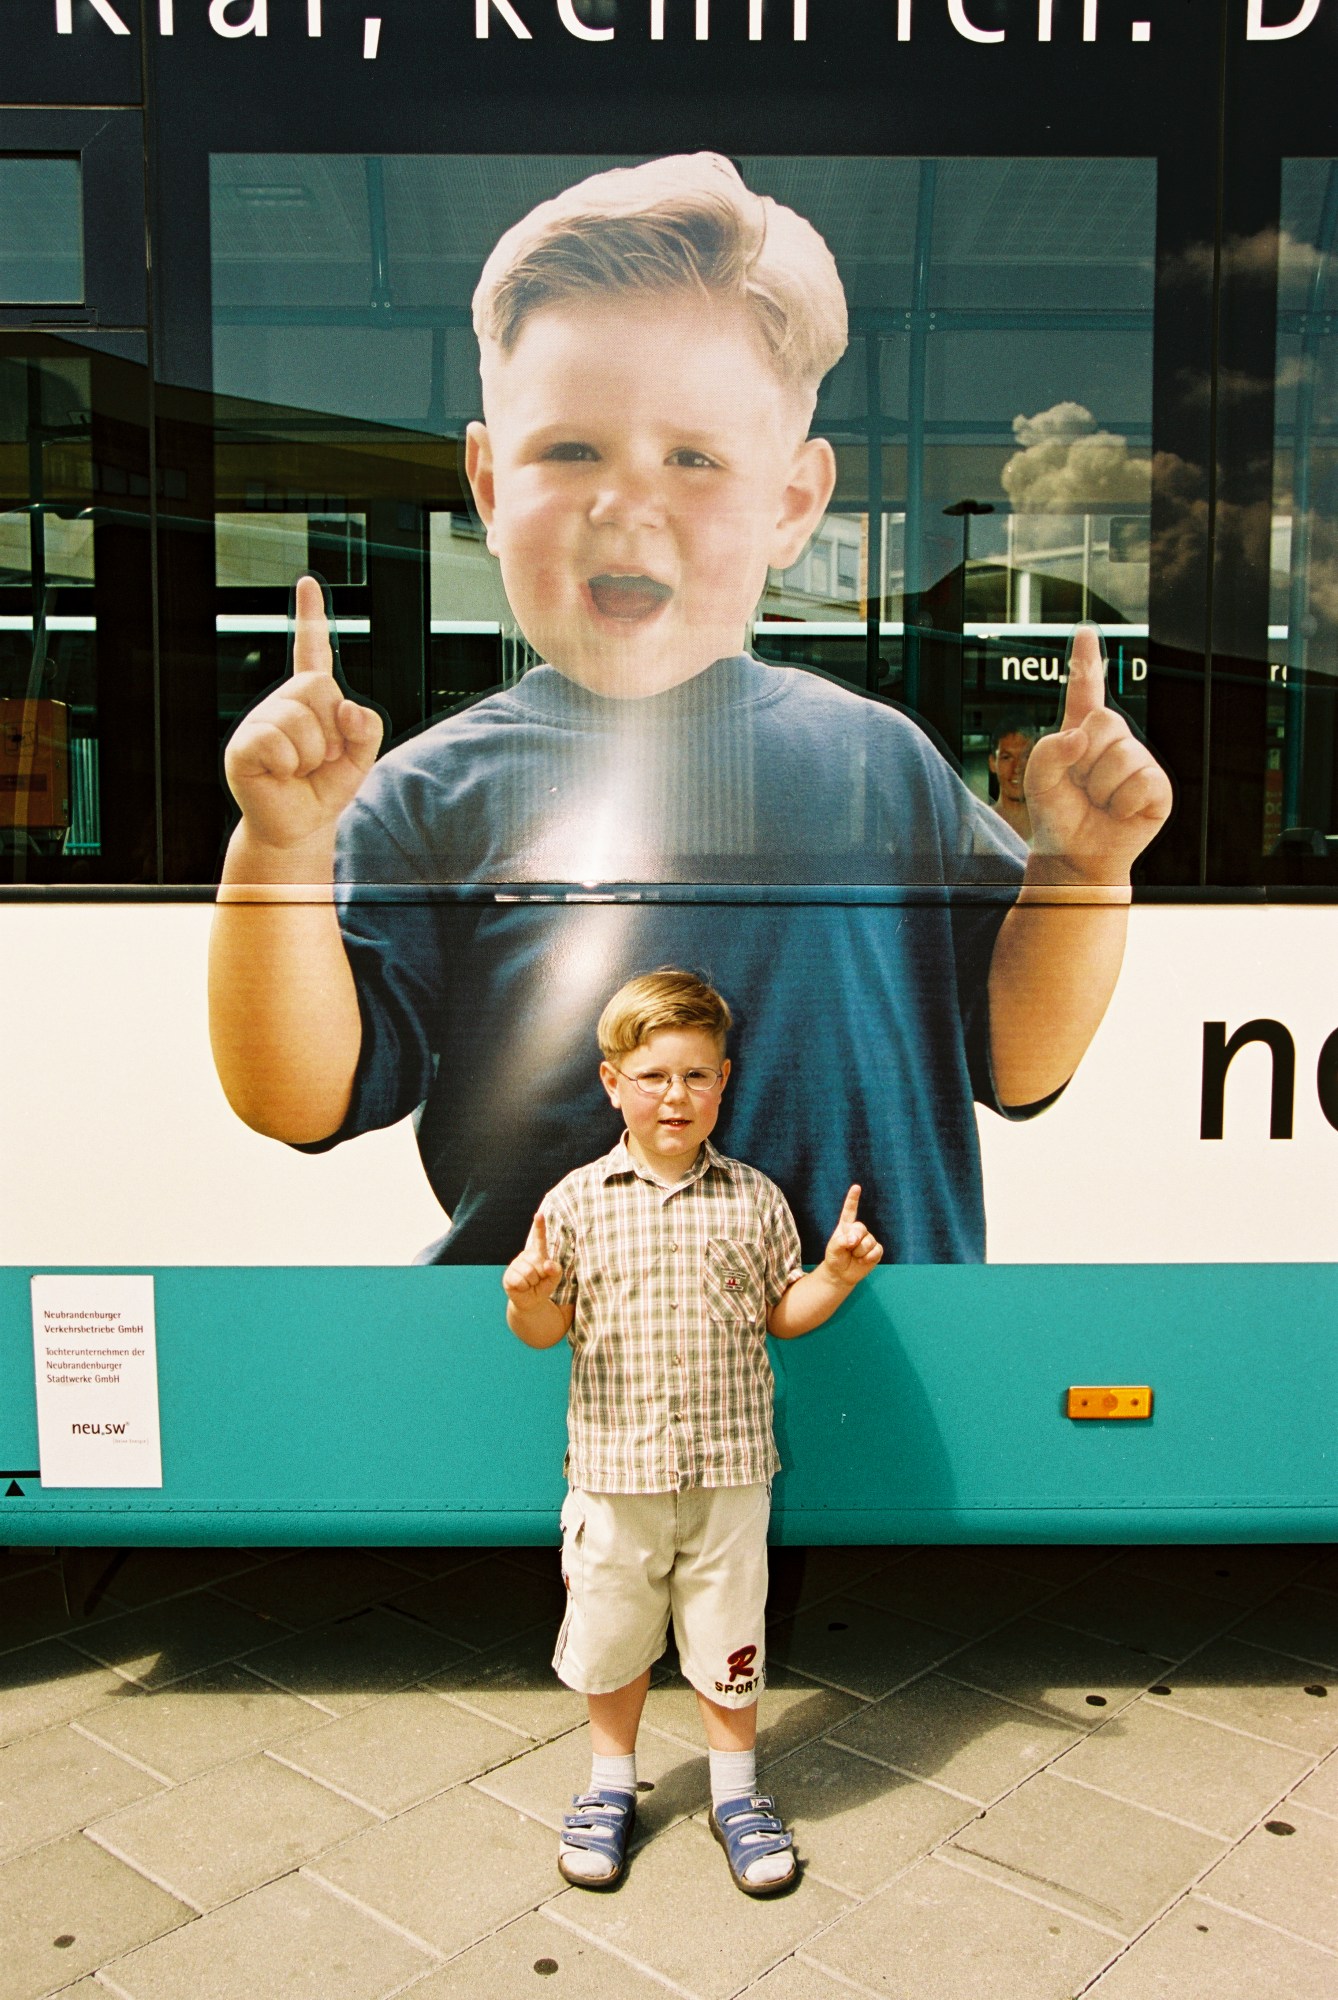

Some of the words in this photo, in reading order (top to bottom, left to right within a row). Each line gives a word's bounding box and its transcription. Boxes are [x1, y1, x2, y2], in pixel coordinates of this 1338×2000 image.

[1002, 656, 1109, 684] neu.
[1199, 1018, 1338, 1140] n
[44, 1310, 122, 1321] Neubrandenburger
[44, 1325, 116, 1334] Verkehrsbetriebe
[117, 1325, 144, 1334] GmbH
[45, 1347, 130, 1357] Tochterunternehmen
[131, 1348, 146, 1357] der
[46, 1361, 123, 1372] Neubrandenburger
[46, 1374, 93, 1384] Stadtwerke
[94, 1374, 121, 1384] GmbH
[715, 1676, 760, 1694] SPORT
